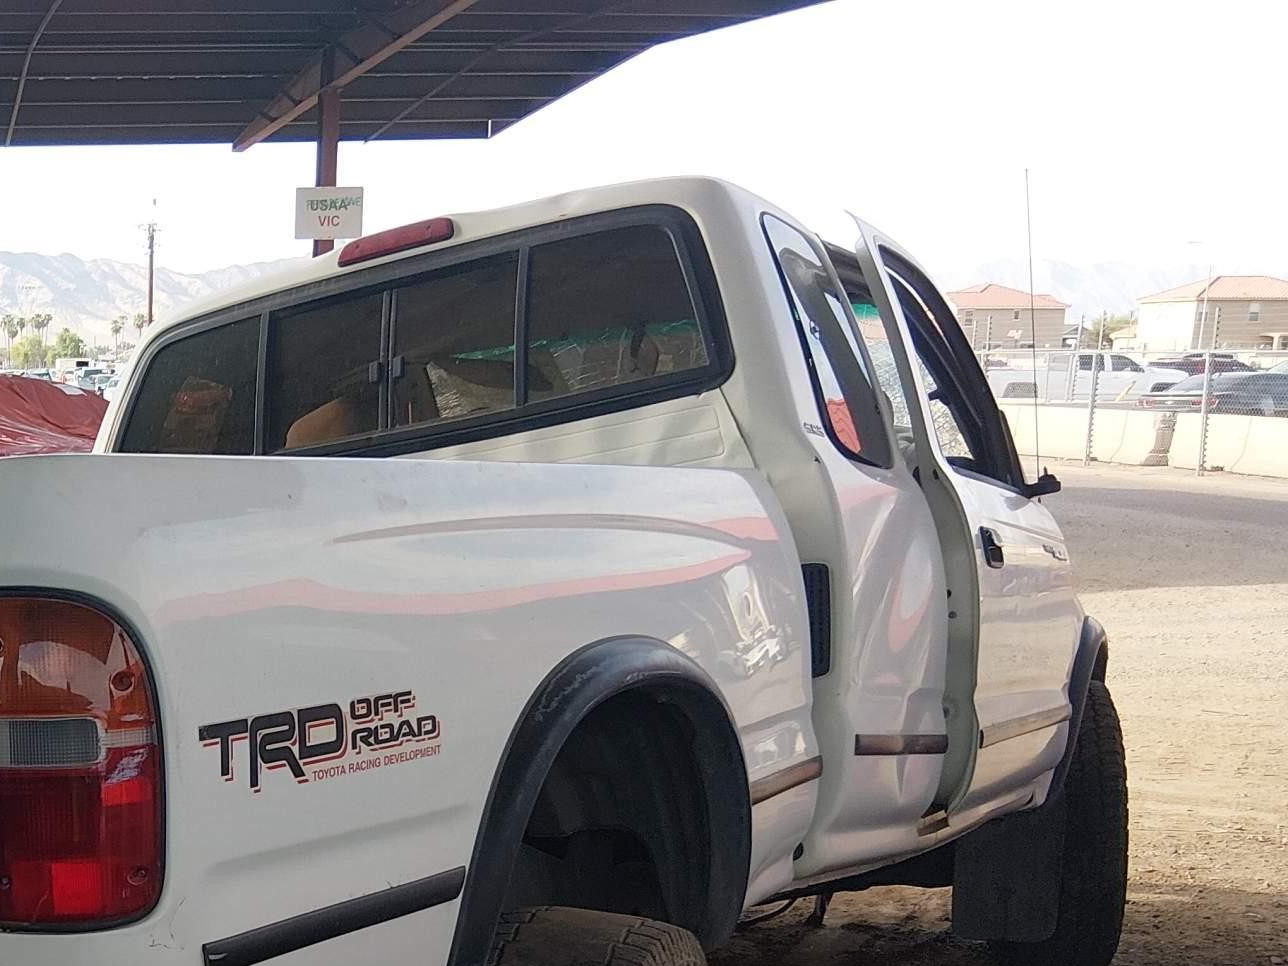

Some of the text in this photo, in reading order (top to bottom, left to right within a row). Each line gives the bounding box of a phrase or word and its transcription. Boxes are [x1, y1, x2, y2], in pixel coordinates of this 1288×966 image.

[310, 199, 348, 211] USAA
[318, 215, 340, 227] VIC
[350, 690, 415, 723] OFF
[198, 702, 348, 793] TRD
[351, 714, 440, 753] ROAD
[311, 744, 441, 781] TOYOTA RACING DEVELOPMENT
